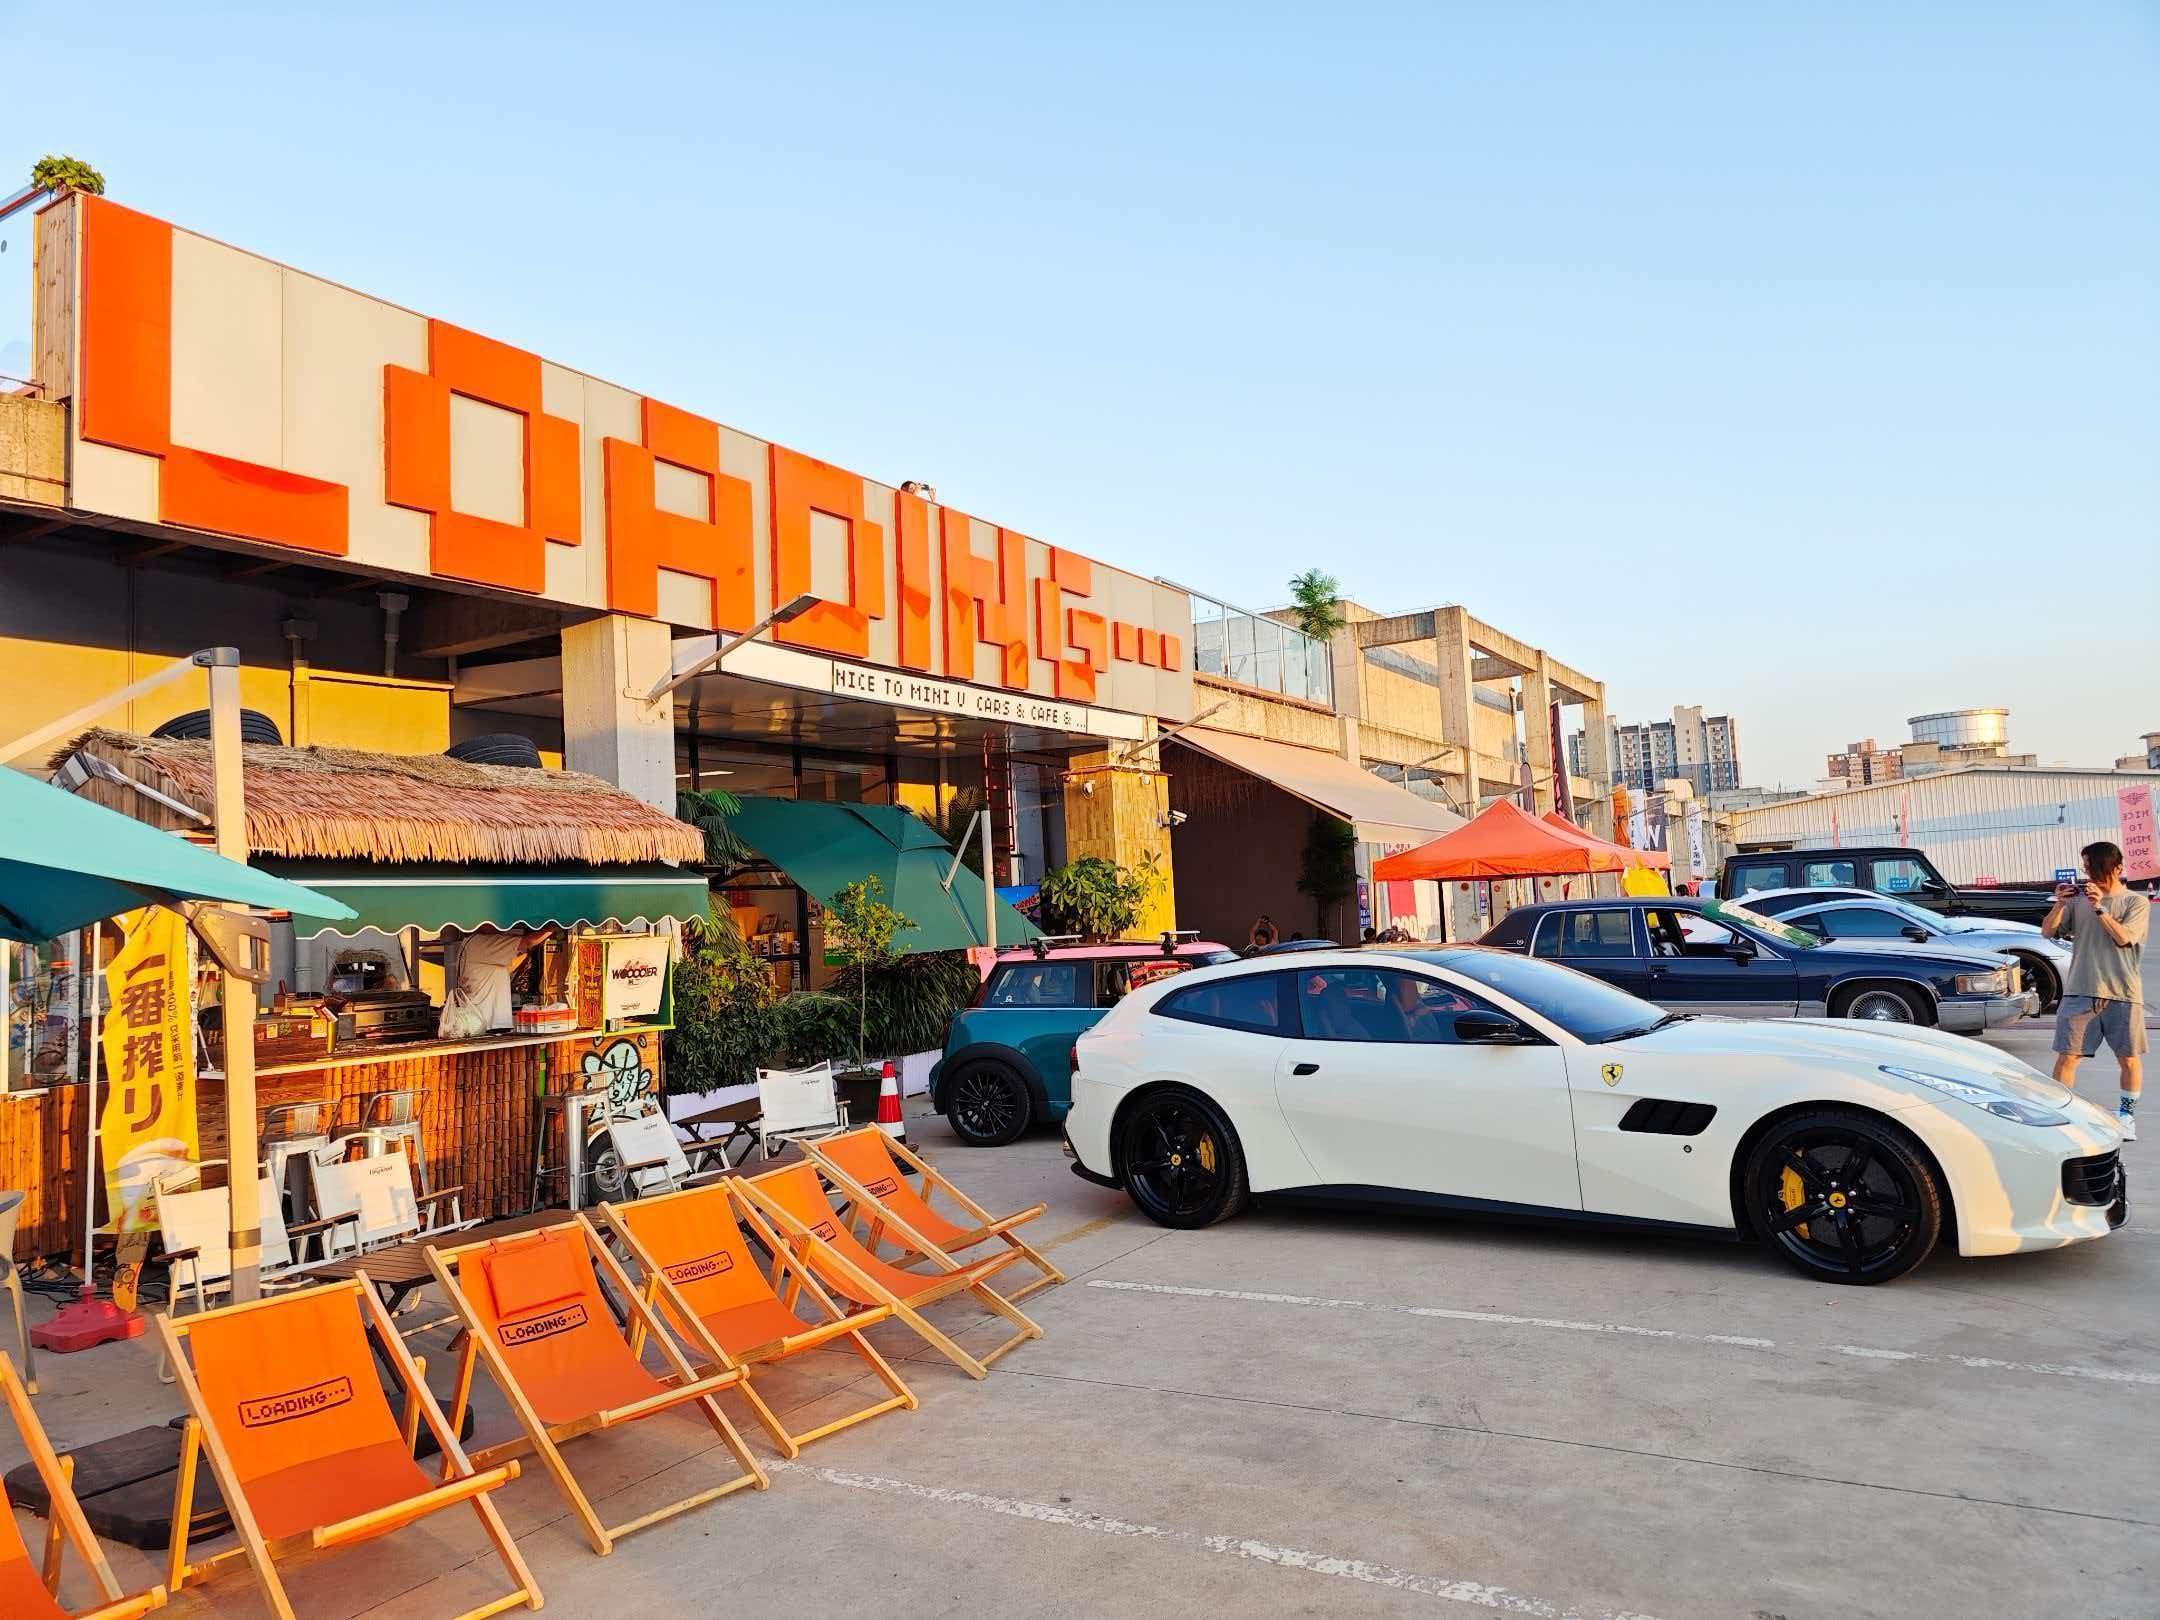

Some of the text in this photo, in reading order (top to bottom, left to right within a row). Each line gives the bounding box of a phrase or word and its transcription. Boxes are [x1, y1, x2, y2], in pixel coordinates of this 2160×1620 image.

[835, 668, 875, 693] NICE
[884, 678, 903, 697] TO
[911, 684, 950, 706] MINI
[957, 692, 966, 707] U
[976, 696, 1010, 716] CARS
[1031, 705, 1058, 724] CAFE
